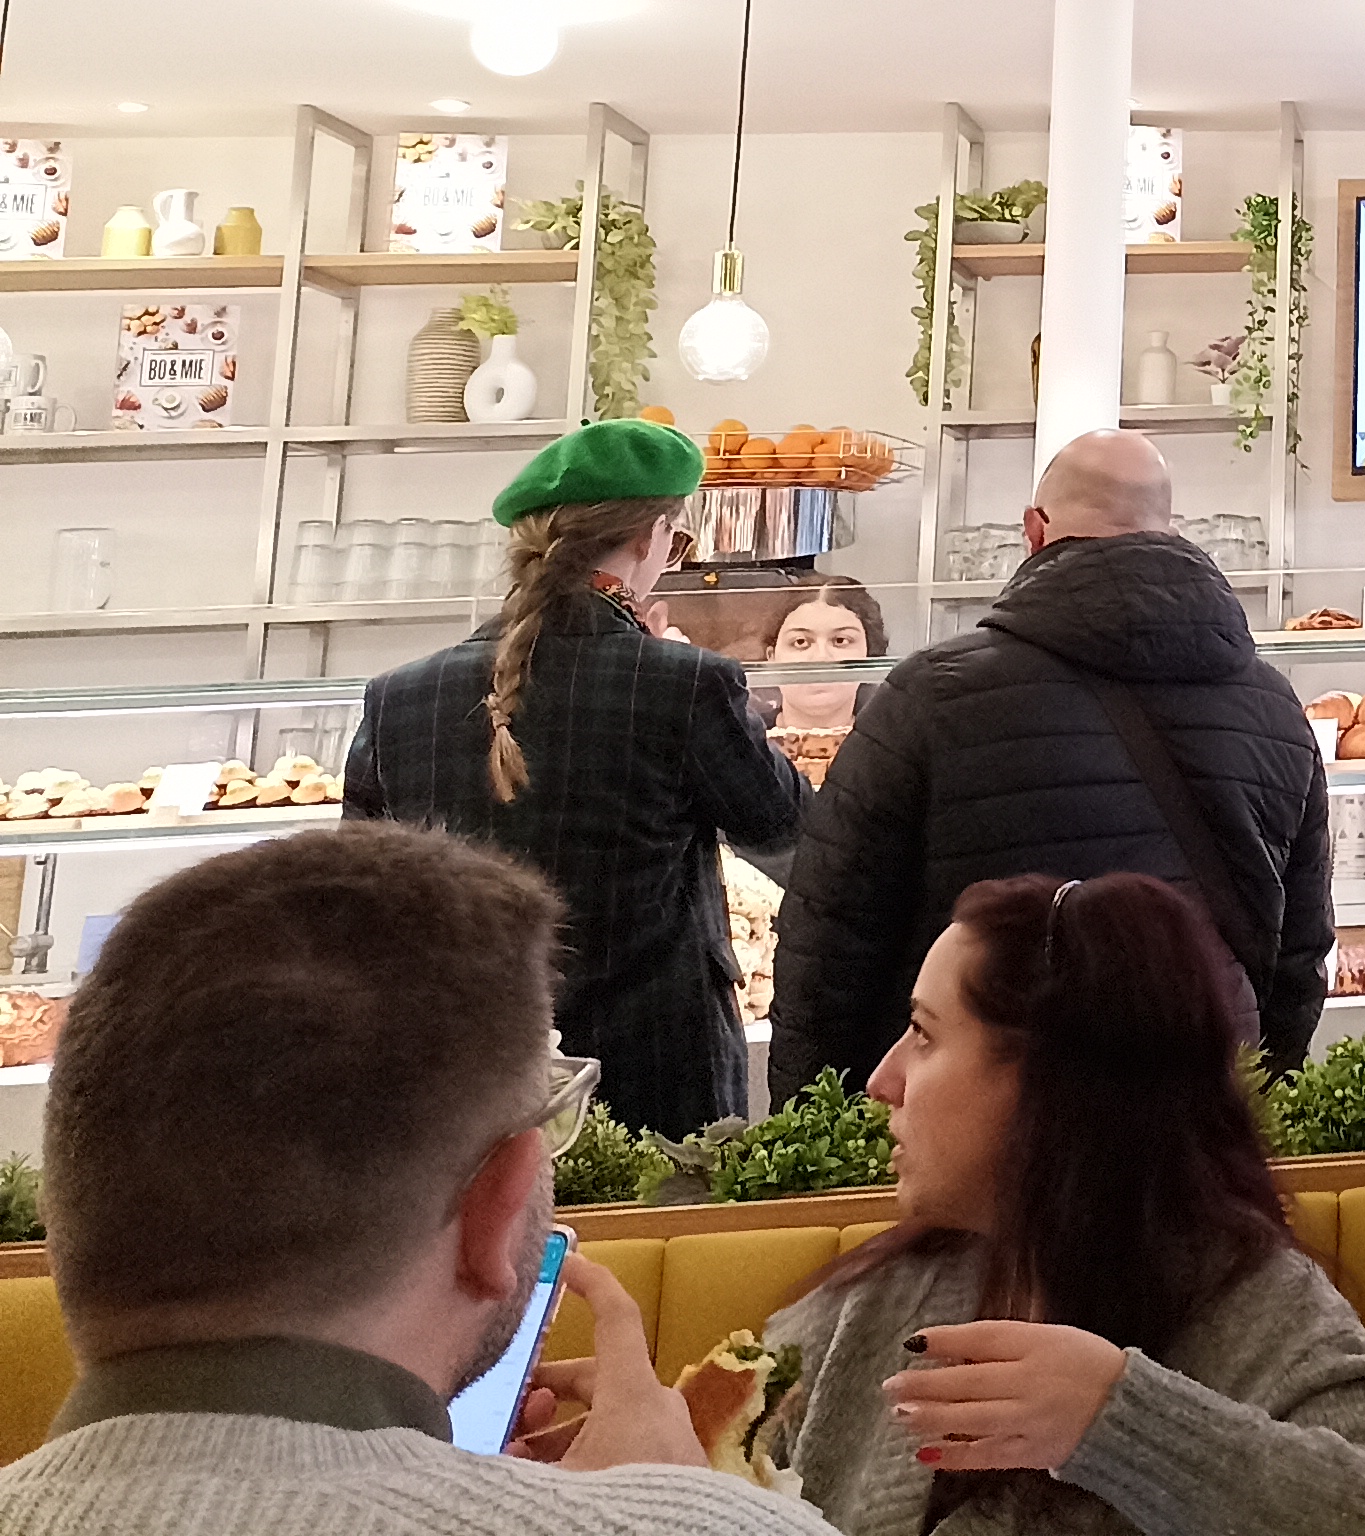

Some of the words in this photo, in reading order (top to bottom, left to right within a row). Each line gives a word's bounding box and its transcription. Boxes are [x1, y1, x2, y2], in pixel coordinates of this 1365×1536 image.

[12, 193, 37, 214] MIE
[148, 359, 167, 380] BO
[169, 359, 177, 380] &
[180, 359, 204, 379] MIE
